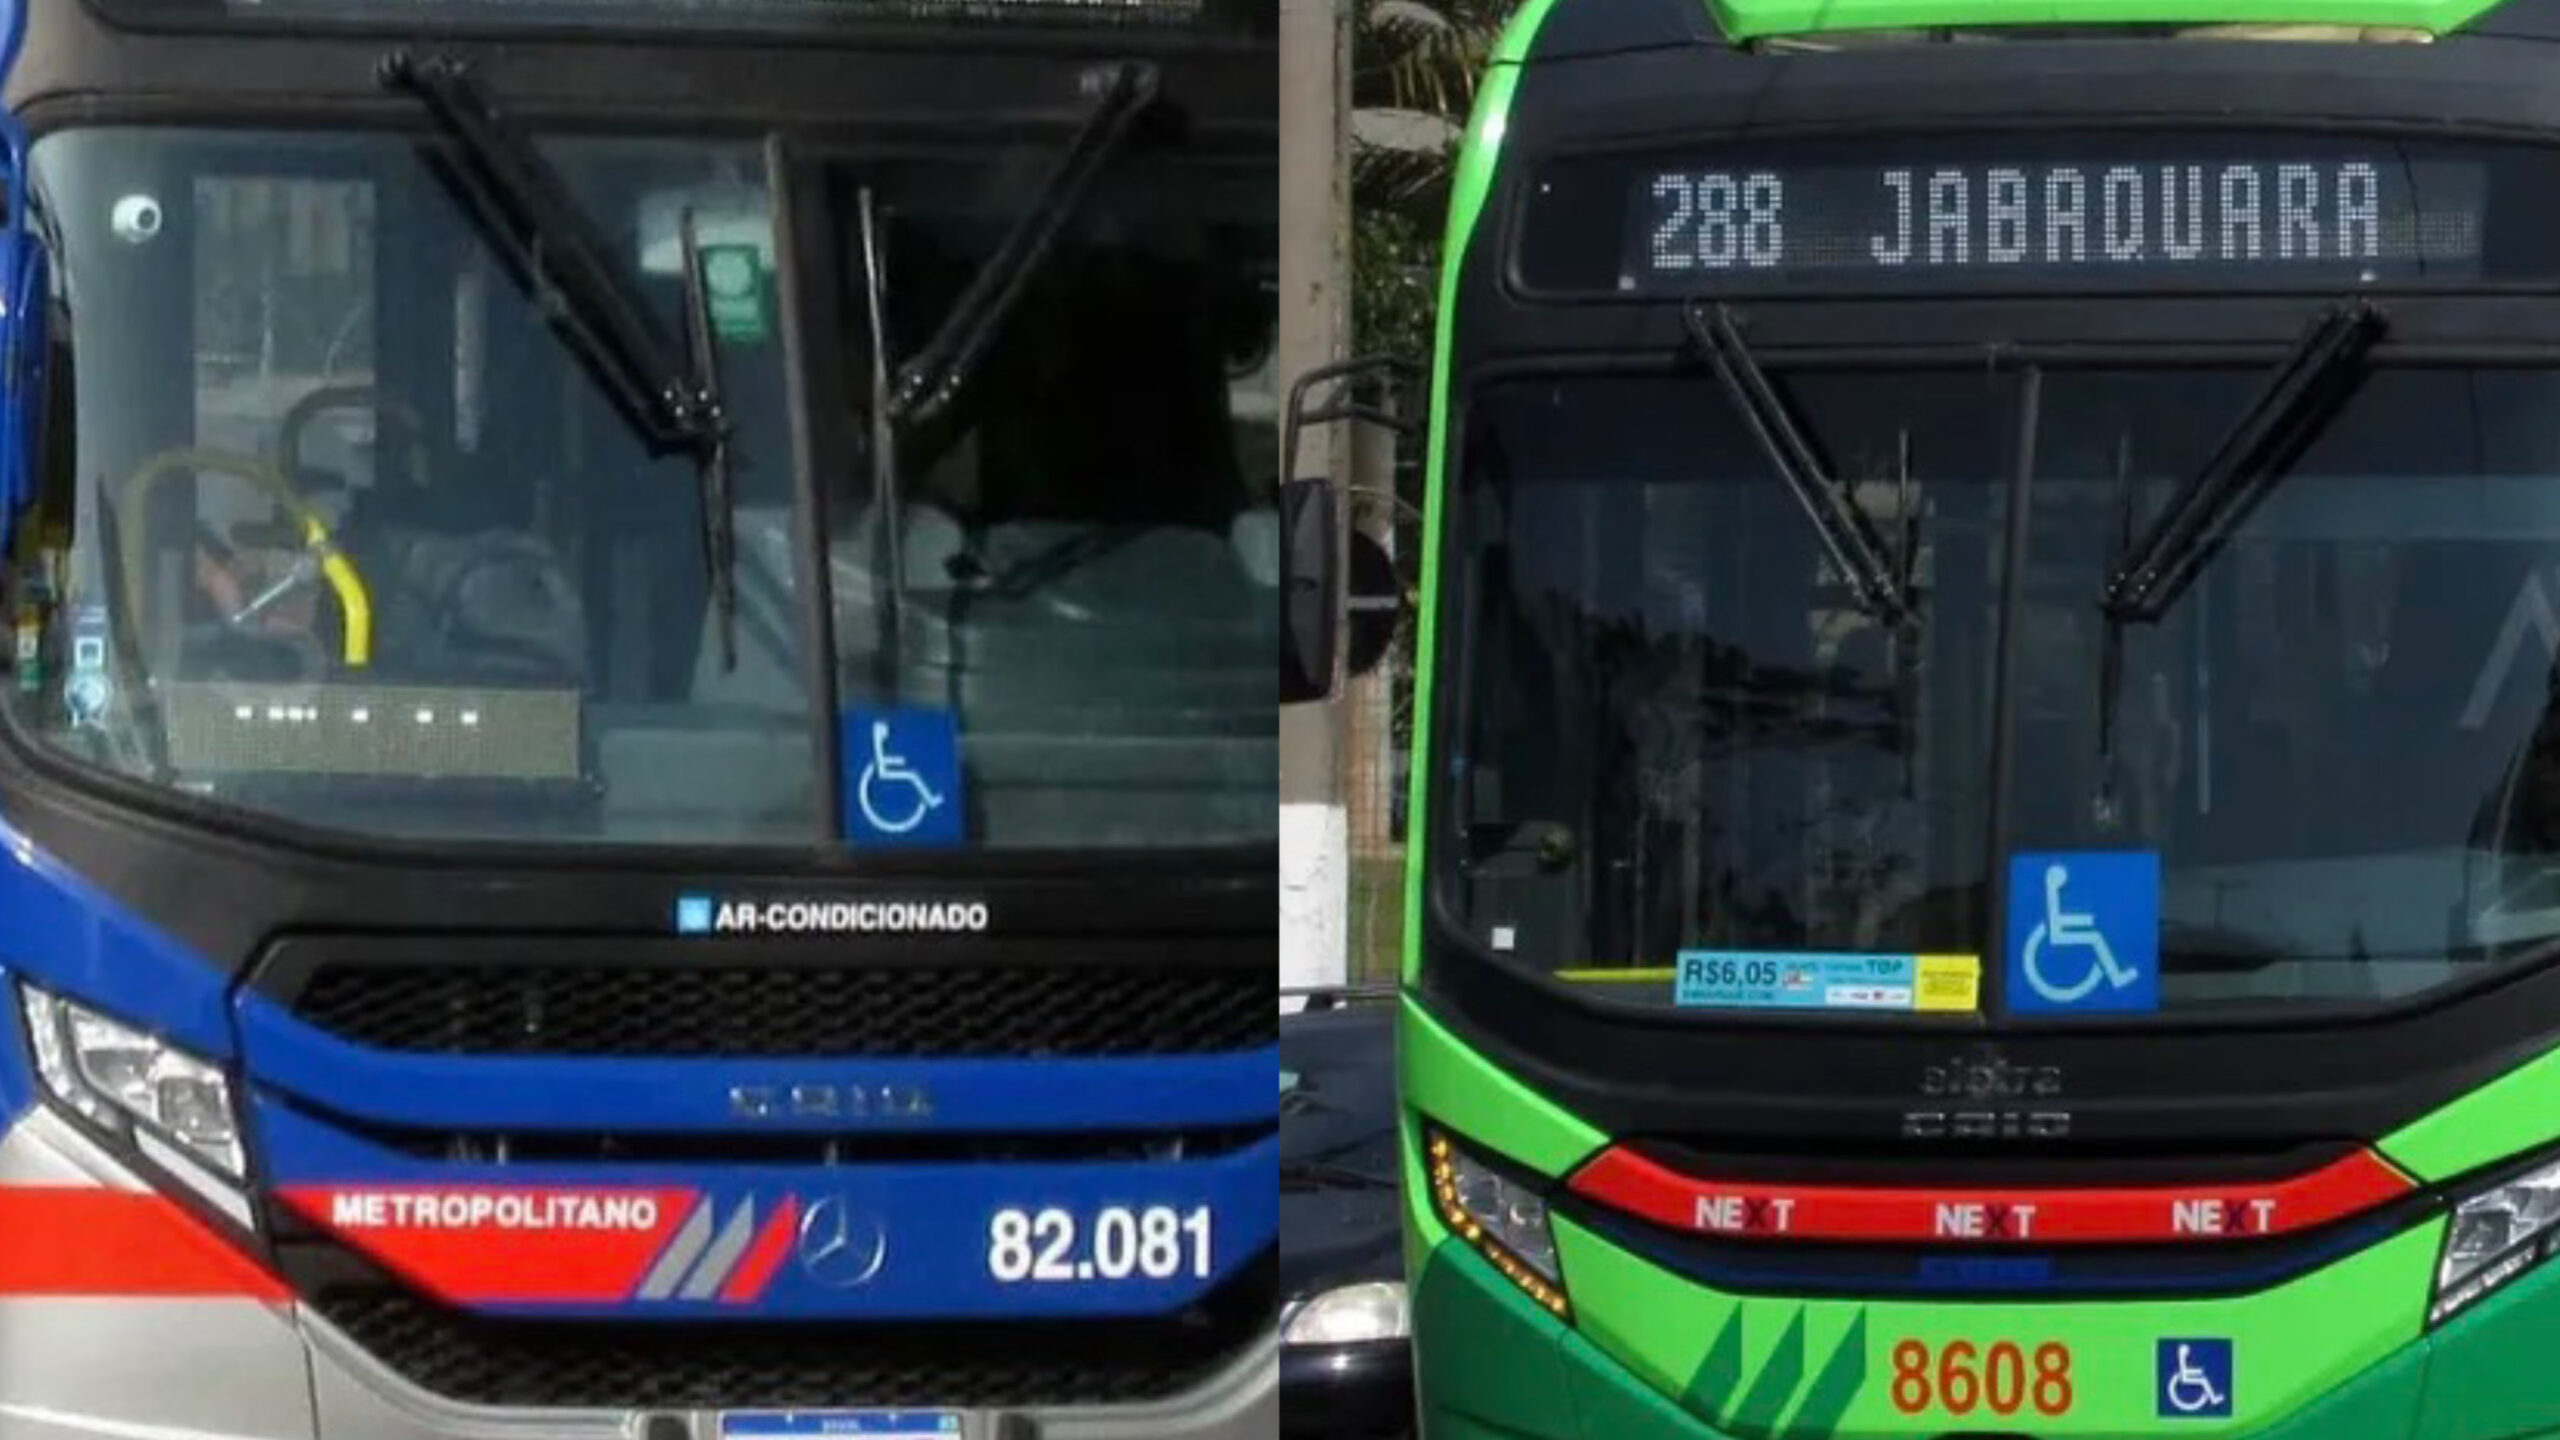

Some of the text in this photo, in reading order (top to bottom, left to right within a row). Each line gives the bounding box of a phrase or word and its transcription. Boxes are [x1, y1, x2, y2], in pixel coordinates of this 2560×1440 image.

[1652, 162, 2379, 267] 288 JABAQUARA
[716, 902, 989, 931] AR-CONDICIONADO
[1684, 960, 1777, 986] R$6,05
[332, 1195, 657, 1229] METROPOLITANO
[1695, 1196, 1794, 1231] NEXT
[1935, 1204, 2035, 1237] NEXT
[2172, 1199, 2275, 1234] NEXT
[988, 1206, 1210, 1282] 82.081
[1891, 1339, 2073, 1416] 8608
